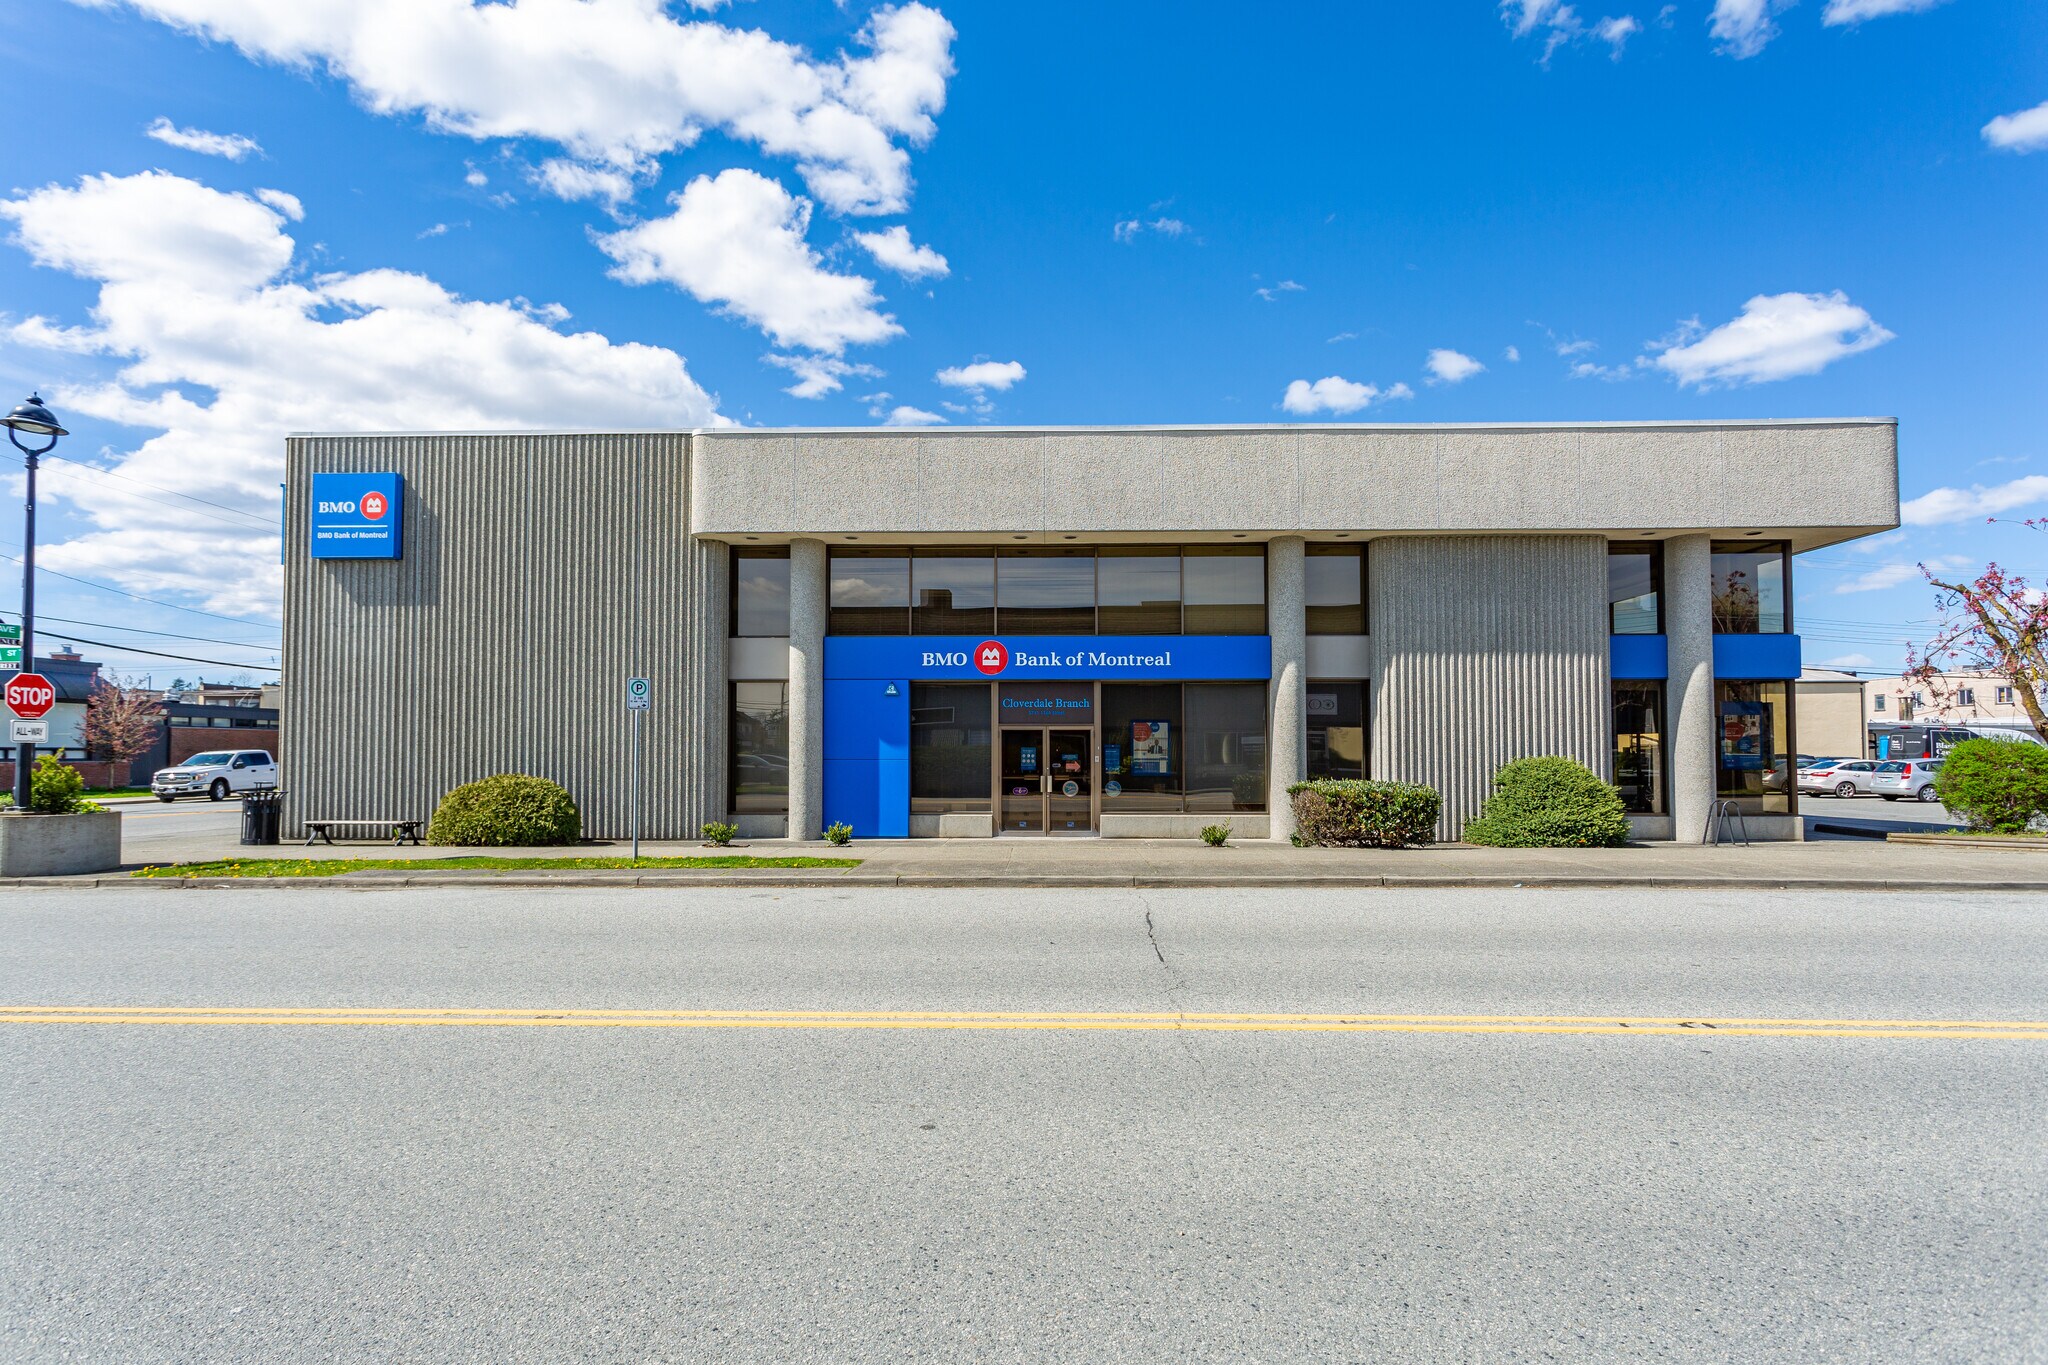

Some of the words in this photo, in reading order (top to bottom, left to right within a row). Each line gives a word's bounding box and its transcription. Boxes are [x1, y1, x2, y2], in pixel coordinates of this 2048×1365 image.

[318, 501, 355, 513] BMO
[317, 531, 333, 539] BMO
[333, 531, 351, 539] Bank
[351, 531, 359, 539] of
[359, 531, 388, 539] Montreal
[922, 652, 968, 666] BMO
[1015, 652, 1062, 666] Bank
[1065, 652, 1085, 666] of
[1088, 652, 1171, 666] Montreal
[9, 686, 52, 706] STOP
[1002, 698, 1053, 708] Cloverdale
[1055, 698, 1090, 708] Branch
[16, 727, 44, 735] ALL-WAY
